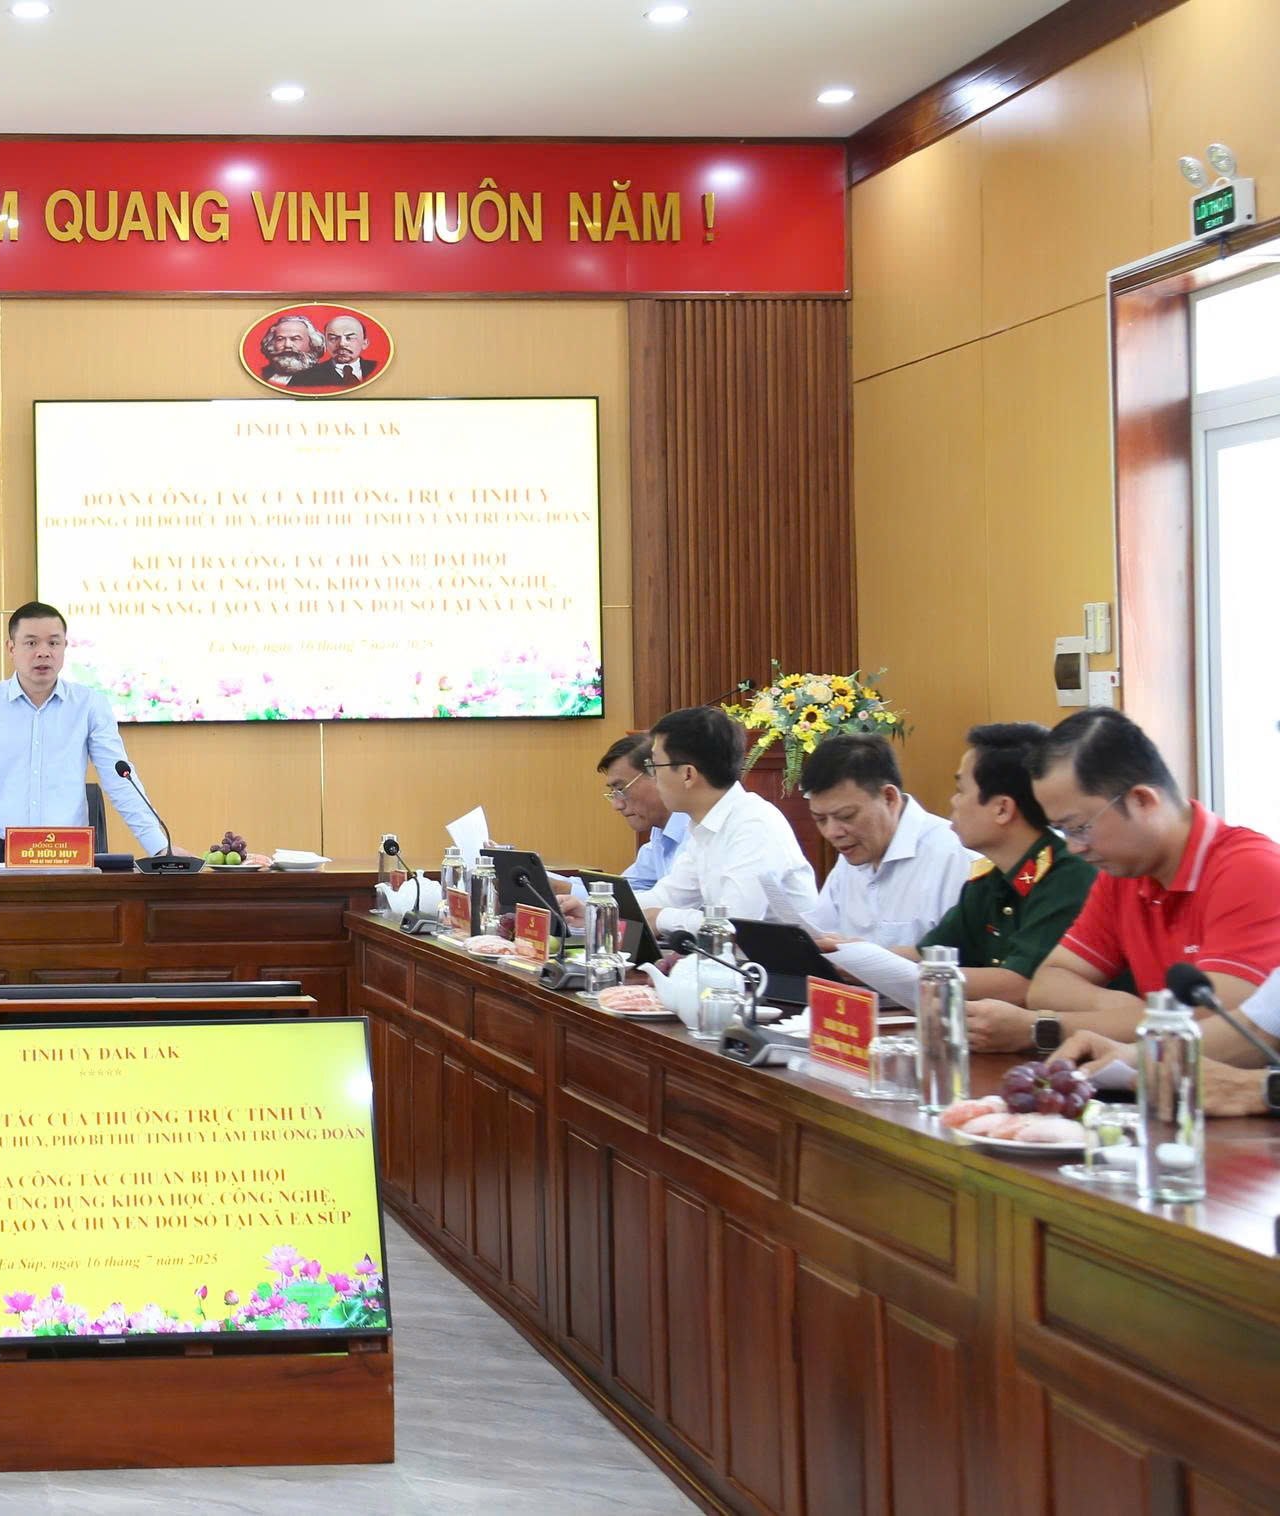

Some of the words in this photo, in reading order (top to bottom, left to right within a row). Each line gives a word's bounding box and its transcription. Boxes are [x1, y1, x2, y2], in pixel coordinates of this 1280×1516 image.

[45, 189, 229, 244] QUANG
[251, 190, 370, 243] VINH
[394, 177, 542, 244] MUÔN
[569, 180, 681, 243] NĂM
[700, 191, 715, 243] !
[19, 1169, 71, 1188] CÔNG
[111, 1193, 166, 1207] KHOA
[219, 1186, 273, 1205] CÔNG
[290, 1211, 317, 1225] EA
[187, 1254, 219, 1266] 2025
